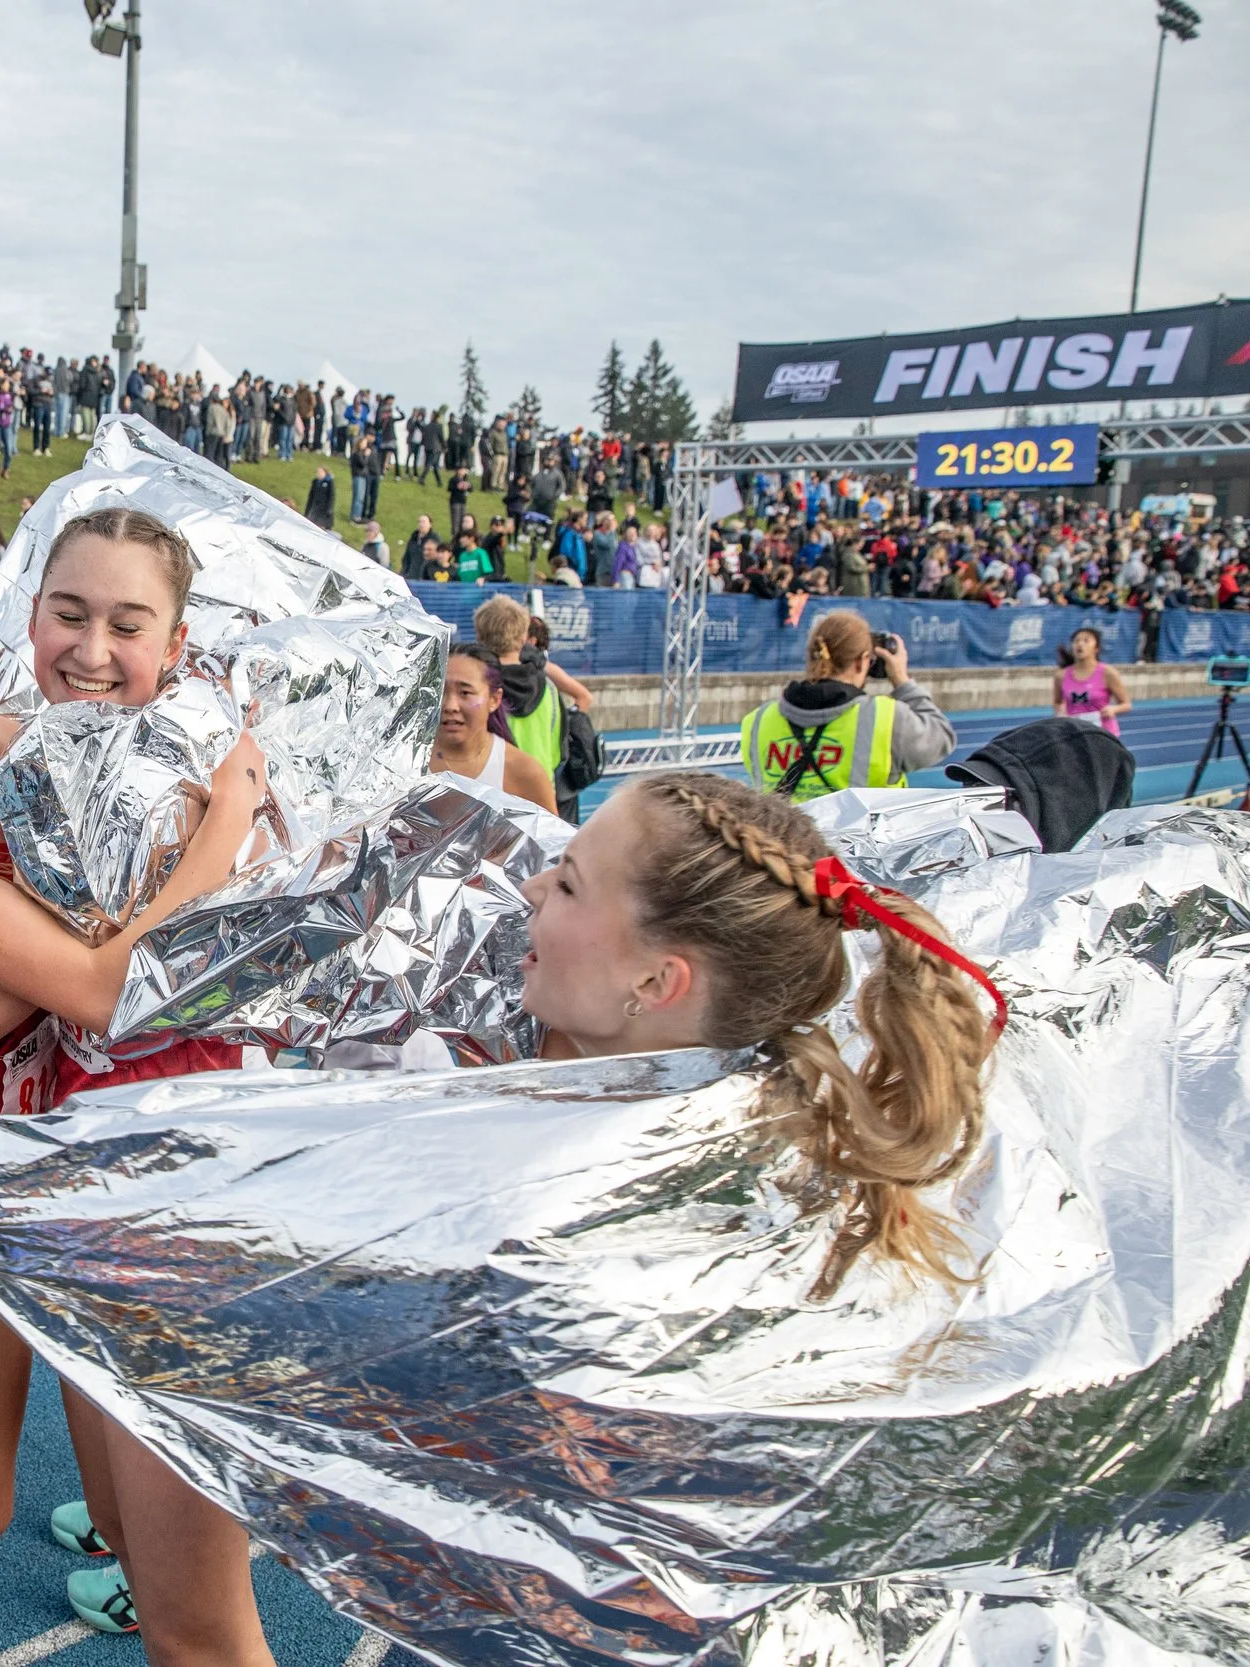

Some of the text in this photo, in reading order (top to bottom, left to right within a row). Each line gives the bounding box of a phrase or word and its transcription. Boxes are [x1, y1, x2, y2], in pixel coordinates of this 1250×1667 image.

[874, 326, 1194, 403] FINISH
[935, 438, 1075, 477] 21:30.2
[766, 740, 844, 772] NP
[12, 1037, 37, 1069] OSAA
